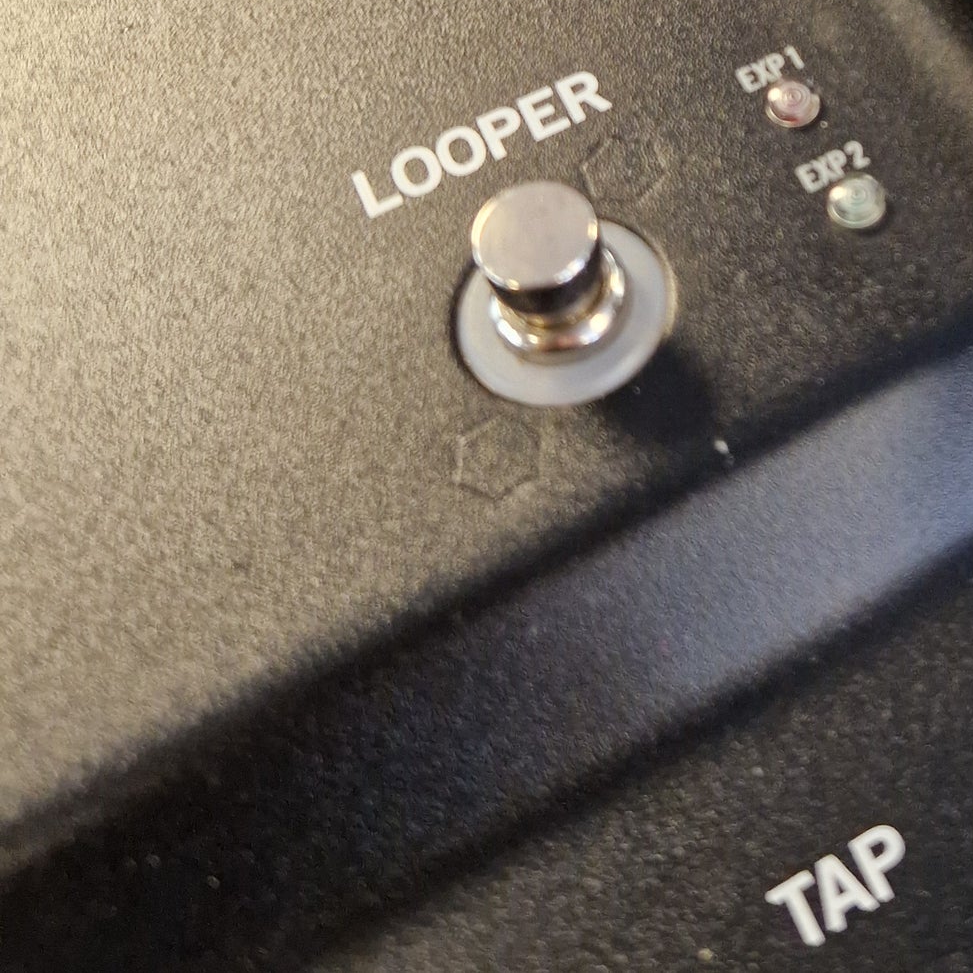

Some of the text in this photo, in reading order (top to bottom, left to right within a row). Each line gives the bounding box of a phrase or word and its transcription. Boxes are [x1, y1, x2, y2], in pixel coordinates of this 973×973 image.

[735, 44, 805, 93] EXP 1
[350, 71, 613, 219] LOOPER
[794, 140, 871, 193] EXP 2
[764, 824, 906, 947] TAP
